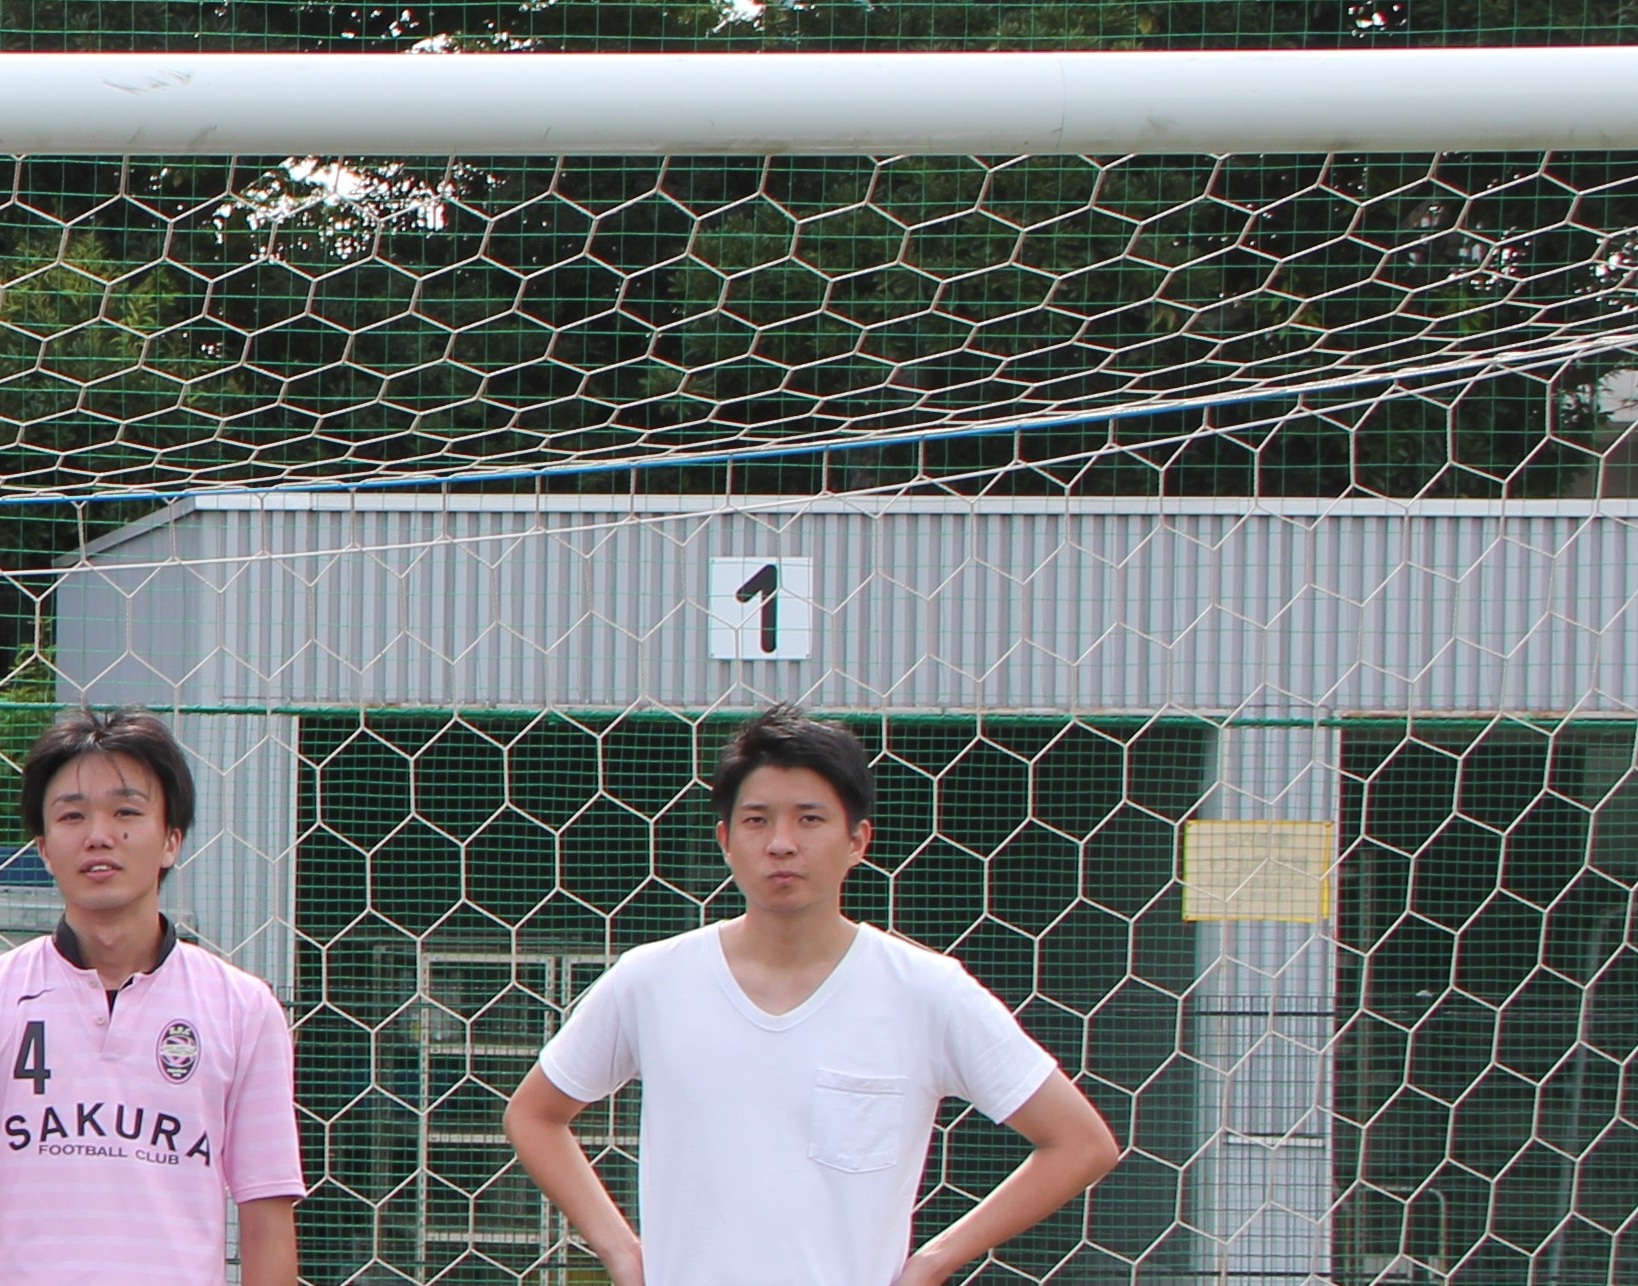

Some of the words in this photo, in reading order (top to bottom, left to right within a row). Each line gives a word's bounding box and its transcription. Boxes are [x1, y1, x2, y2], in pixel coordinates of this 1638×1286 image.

[736, 563, 778, 654] 1
[13, 1020, 52, 1095] 4
[5, 1102, 211, 1168] SAKURA
[38, 1144, 128, 1158] FOOTBALL
[135, 1148, 180, 1165] CLUB
